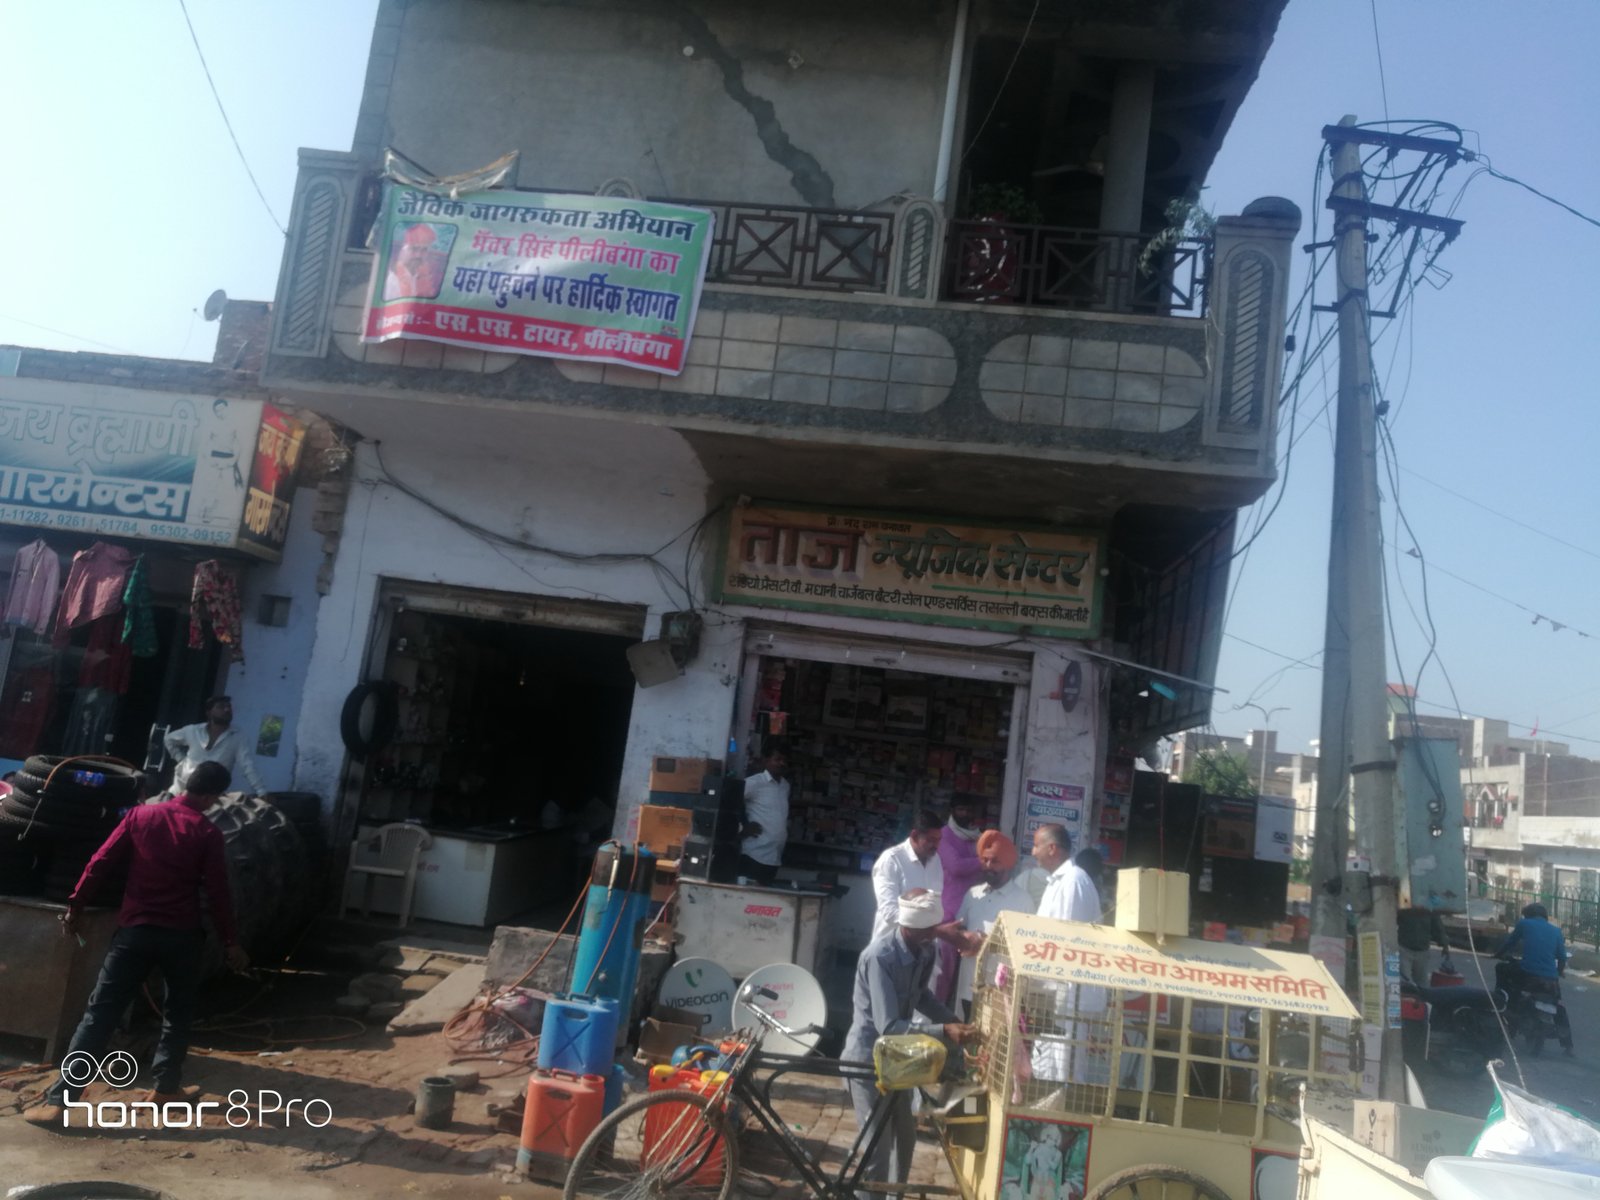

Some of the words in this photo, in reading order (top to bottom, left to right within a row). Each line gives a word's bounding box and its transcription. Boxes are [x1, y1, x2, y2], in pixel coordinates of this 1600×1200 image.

[397, 193, 464, 218] जैविक
[593, 209, 696, 241] अभियान
[518, 233, 555, 260] सिंह
[559, 236, 645, 268] पीलीबंगा
[648, 250, 681, 275] का
[542, 276, 563, 303] पर
[568, 272, 624, 314] हार्दिक
[626, 288, 681, 322] स्वागत
[584, 330, 673, 361] पीलीबंगा
[742, 518, 867, 573] ताज
[871, 526, 992, 581] म्यूजिक
[993, 533, 1091, 588] सेन्टर
[1024, 940, 1061, 962] श्री
[1113, 953, 1167, 977] सेवा
[1169, 965, 1248, 990] आश्रम
[1249, 974, 1329, 1000] समिति
[1055, 967, 1064, 976] 2
[666, 991, 729, 1009] VIDEOCON
